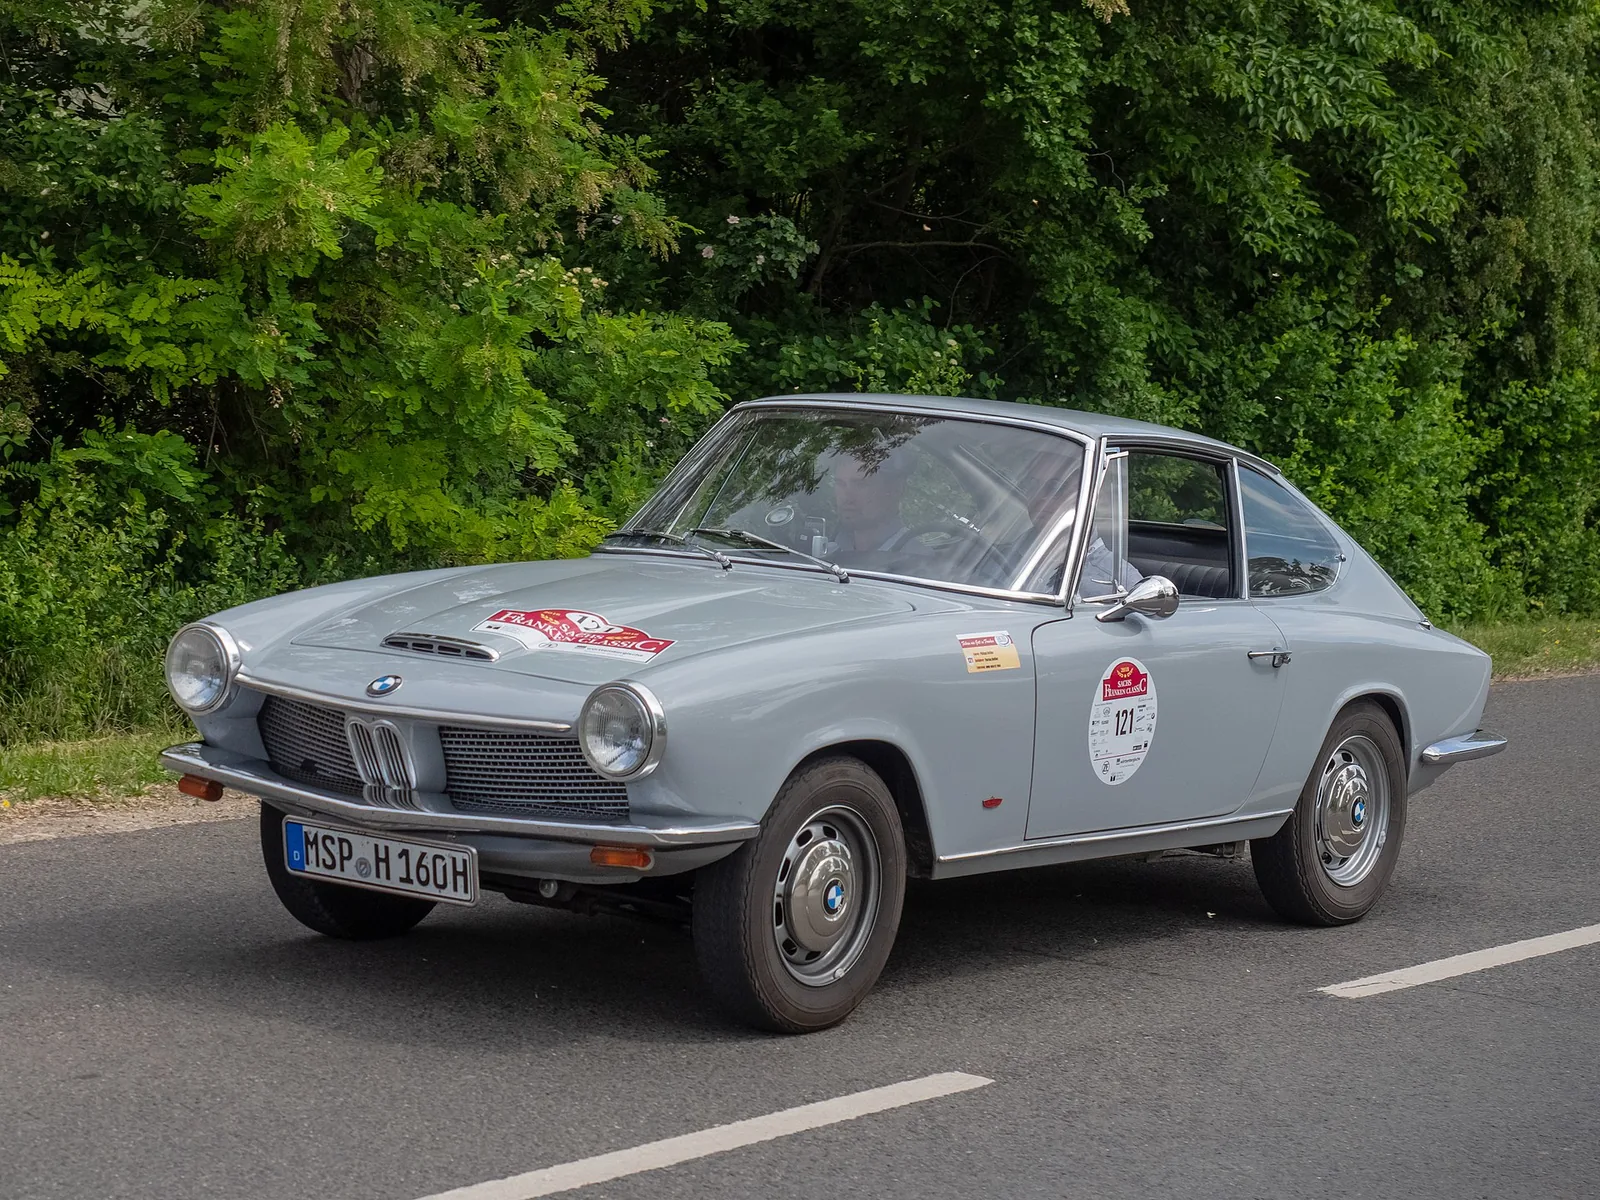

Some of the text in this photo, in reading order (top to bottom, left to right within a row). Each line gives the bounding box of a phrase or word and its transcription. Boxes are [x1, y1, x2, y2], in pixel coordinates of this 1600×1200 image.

[496, 612, 665, 651] FRANKEN CLASSIC
[560, 623, 605, 640] SACHS
[1104, 677, 1147, 698] FRANKEN CLASSIC
[1117, 679, 1132, 688] SACHS
[1115, 707, 1134, 736] 121
[293, 850, 301, 861] D
[304, 830, 469, 895] MSP H 160H
